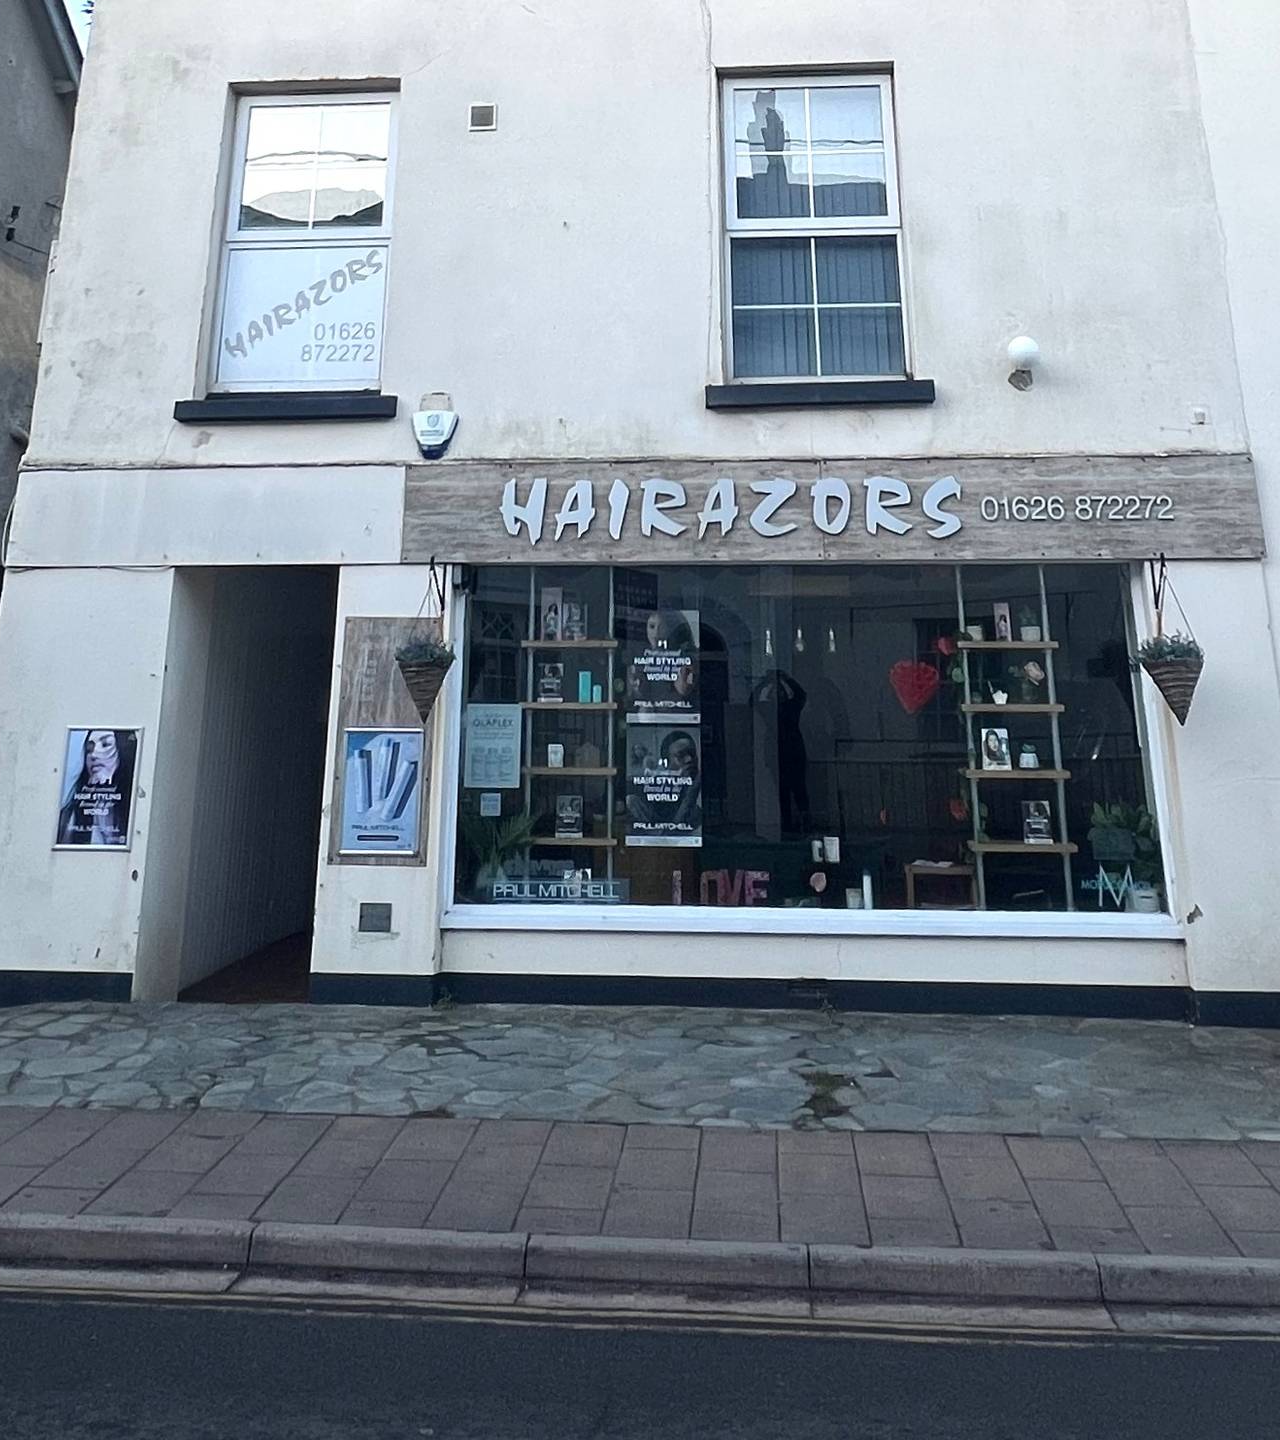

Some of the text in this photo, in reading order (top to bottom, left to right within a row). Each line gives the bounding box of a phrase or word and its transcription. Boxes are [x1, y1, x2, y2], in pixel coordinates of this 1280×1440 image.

[224, 250, 383, 358] HAIRAZORS
[314, 322, 375, 341] 01626
[301, 344, 375, 362] 872272
[500, 475, 1175, 546] HAIRAZORS 01626 872272
[634, 657, 654, 665] HAIR
[646, 673, 678, 681] WORLD
[633, 776, 692, 785] HAIR STYLING
[647, 793, 679, 801] WORLD
[493, 883, 619, 898] PAUL MITCHELL
